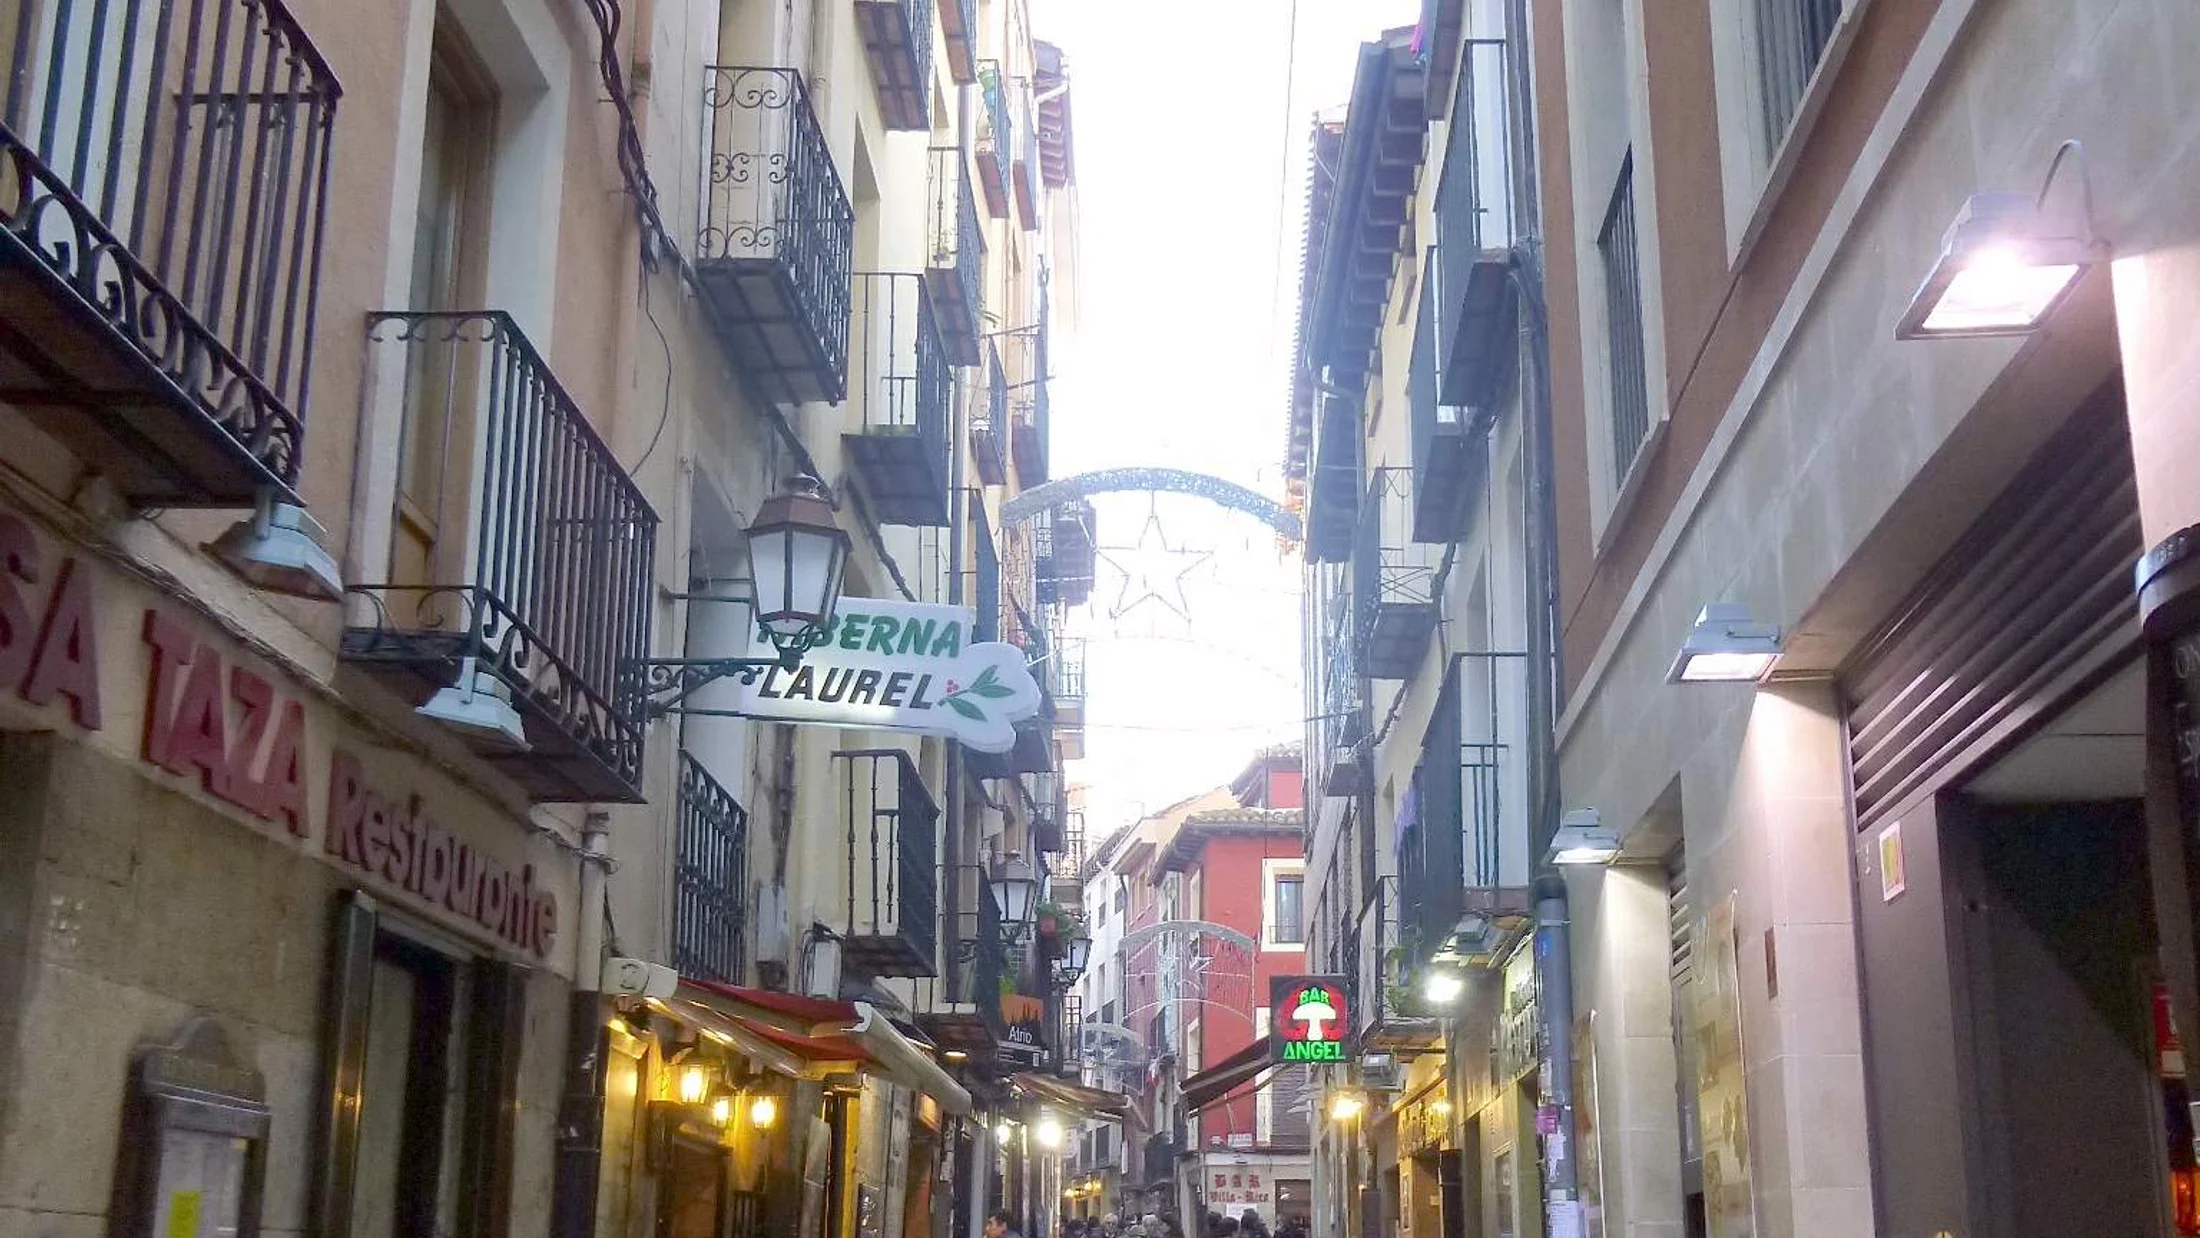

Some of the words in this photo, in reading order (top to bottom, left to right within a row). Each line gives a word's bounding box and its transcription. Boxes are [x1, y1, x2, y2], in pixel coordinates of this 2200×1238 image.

[757, 613, 961, 658] BERNA
[758, 664, 933, 709] LAUREL
[140, 609, 310, 838] TAZA
[324, 751, 557, 958] Restaurante
[1299, 987, 1330, 1005] BAR
[1283, 1041, 1346, 1060] ANGEL
